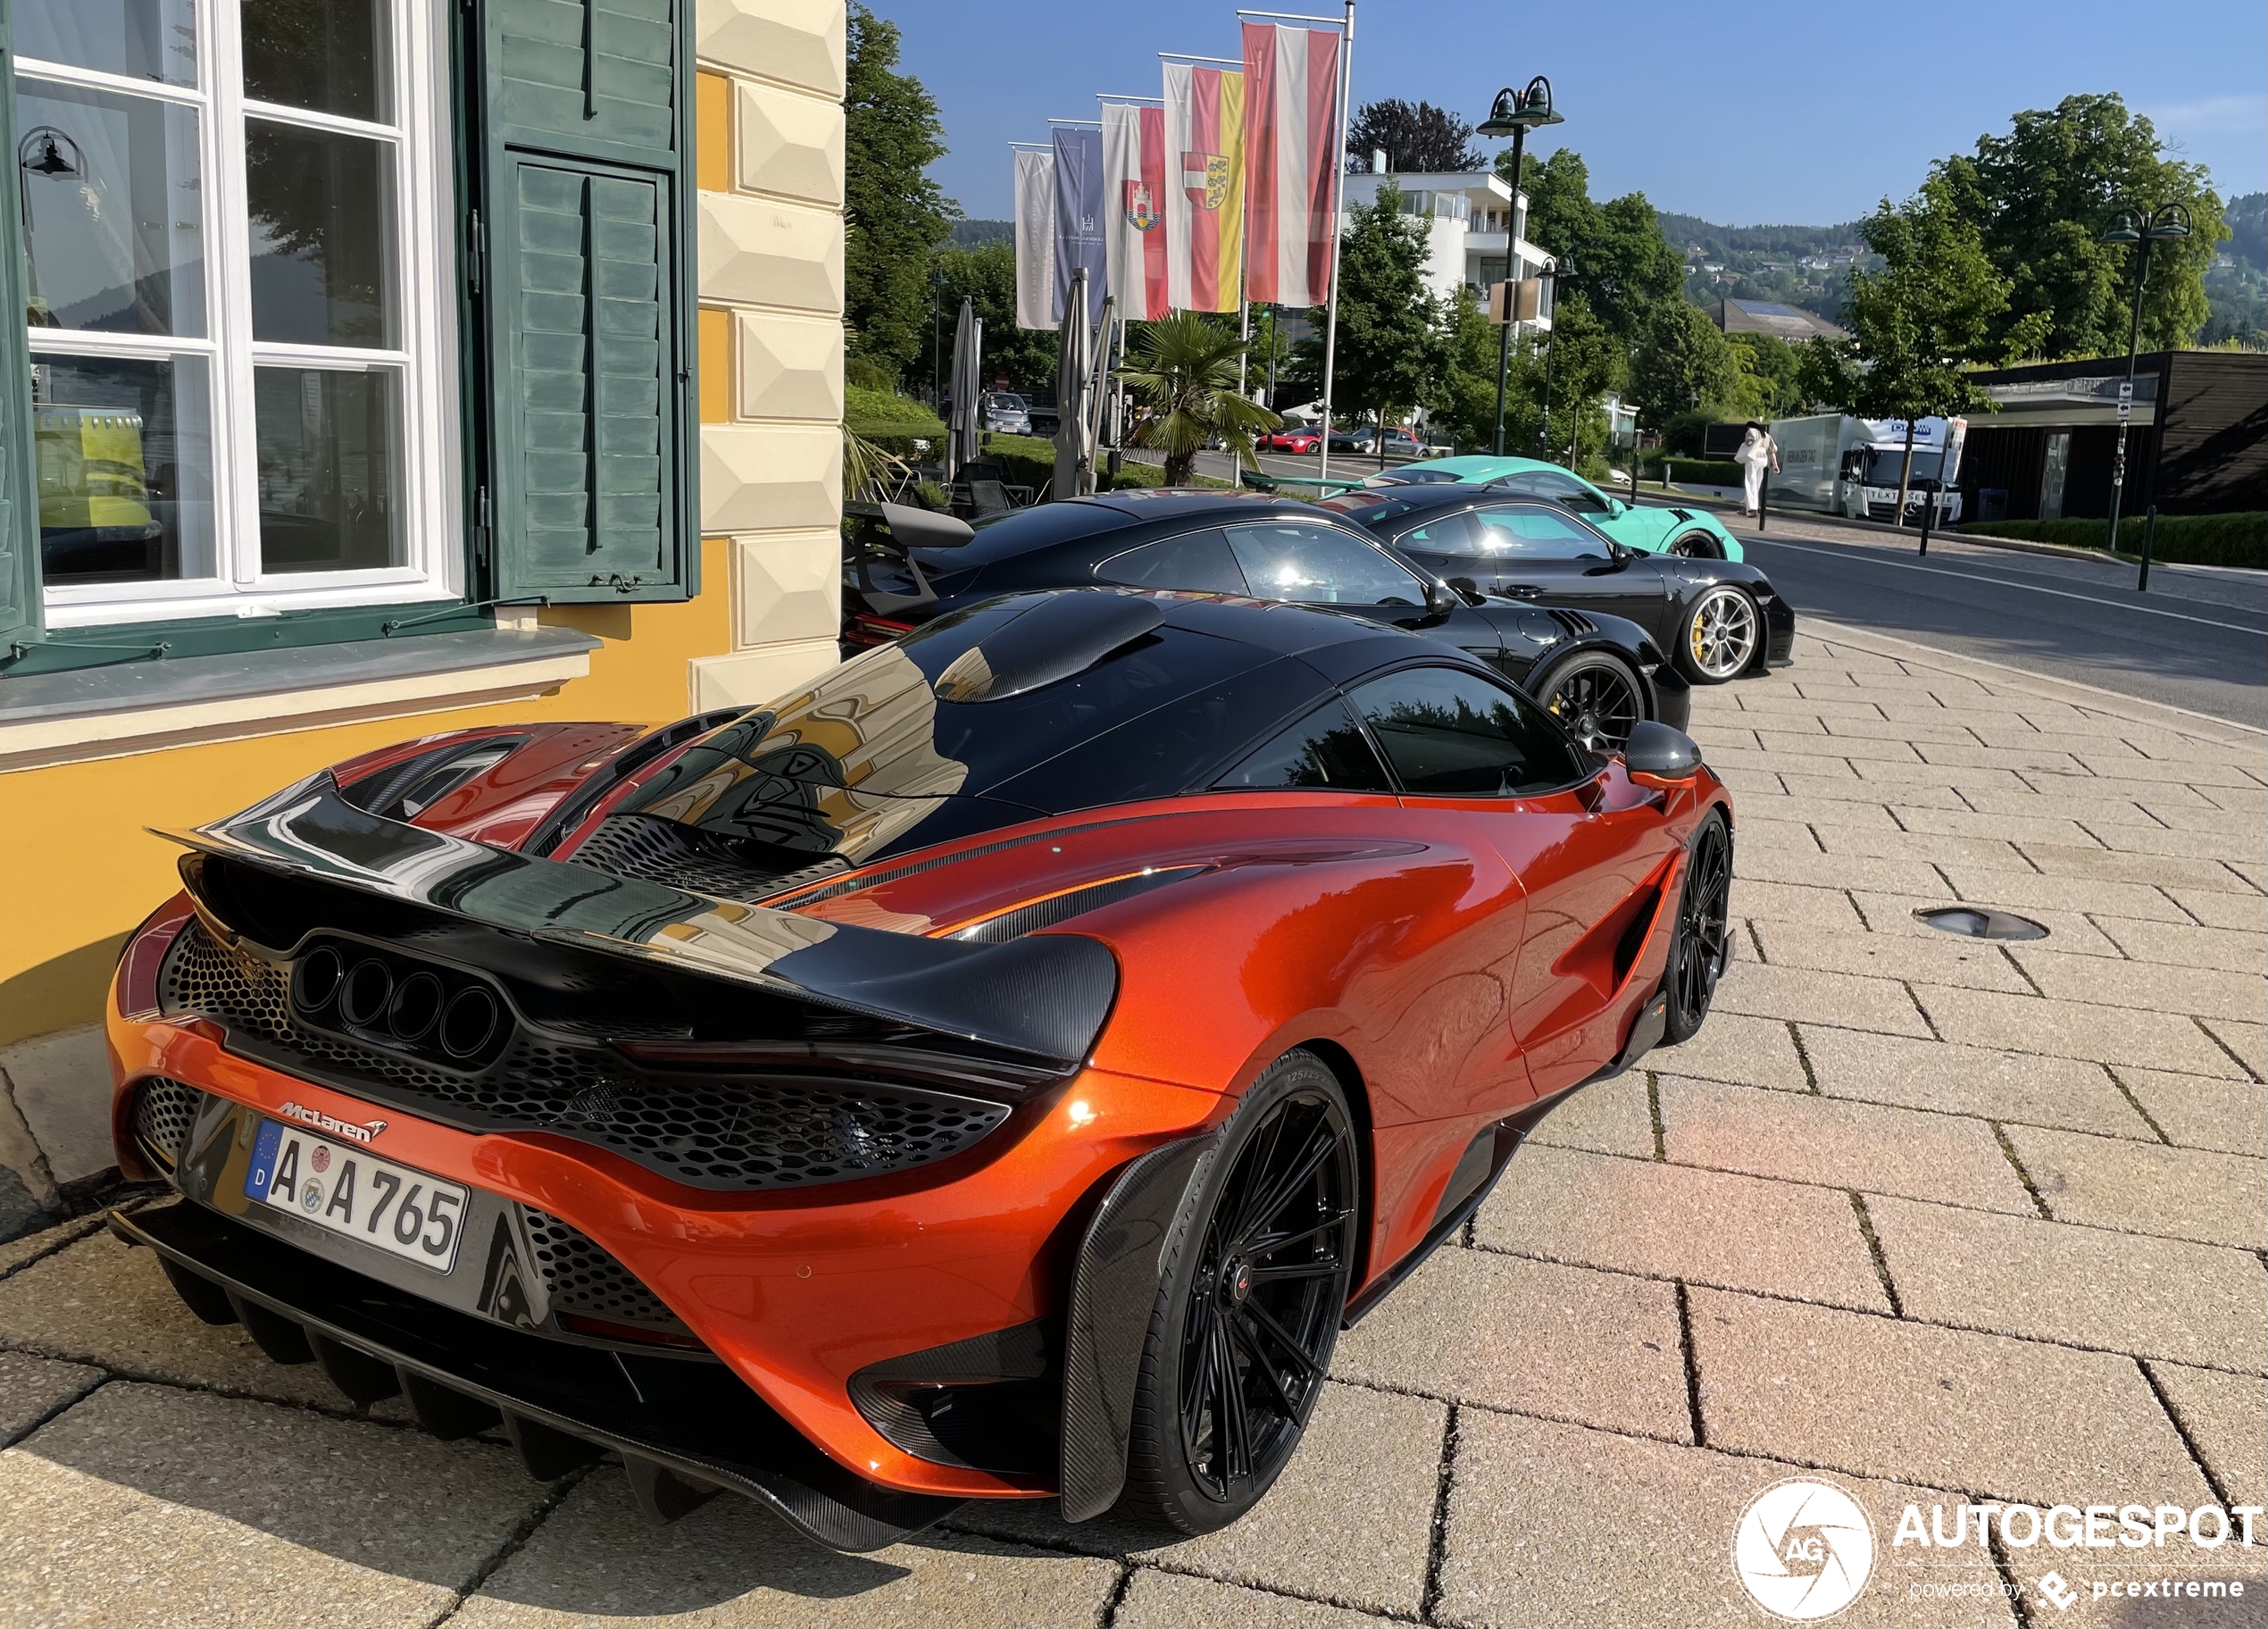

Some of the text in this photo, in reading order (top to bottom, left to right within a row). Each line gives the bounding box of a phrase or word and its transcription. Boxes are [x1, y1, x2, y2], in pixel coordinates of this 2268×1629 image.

[277, 1101, 371, 1142] McLaren
[255, 1168, 266, 1187] D
[368, 1170, 460, 1256] 765
